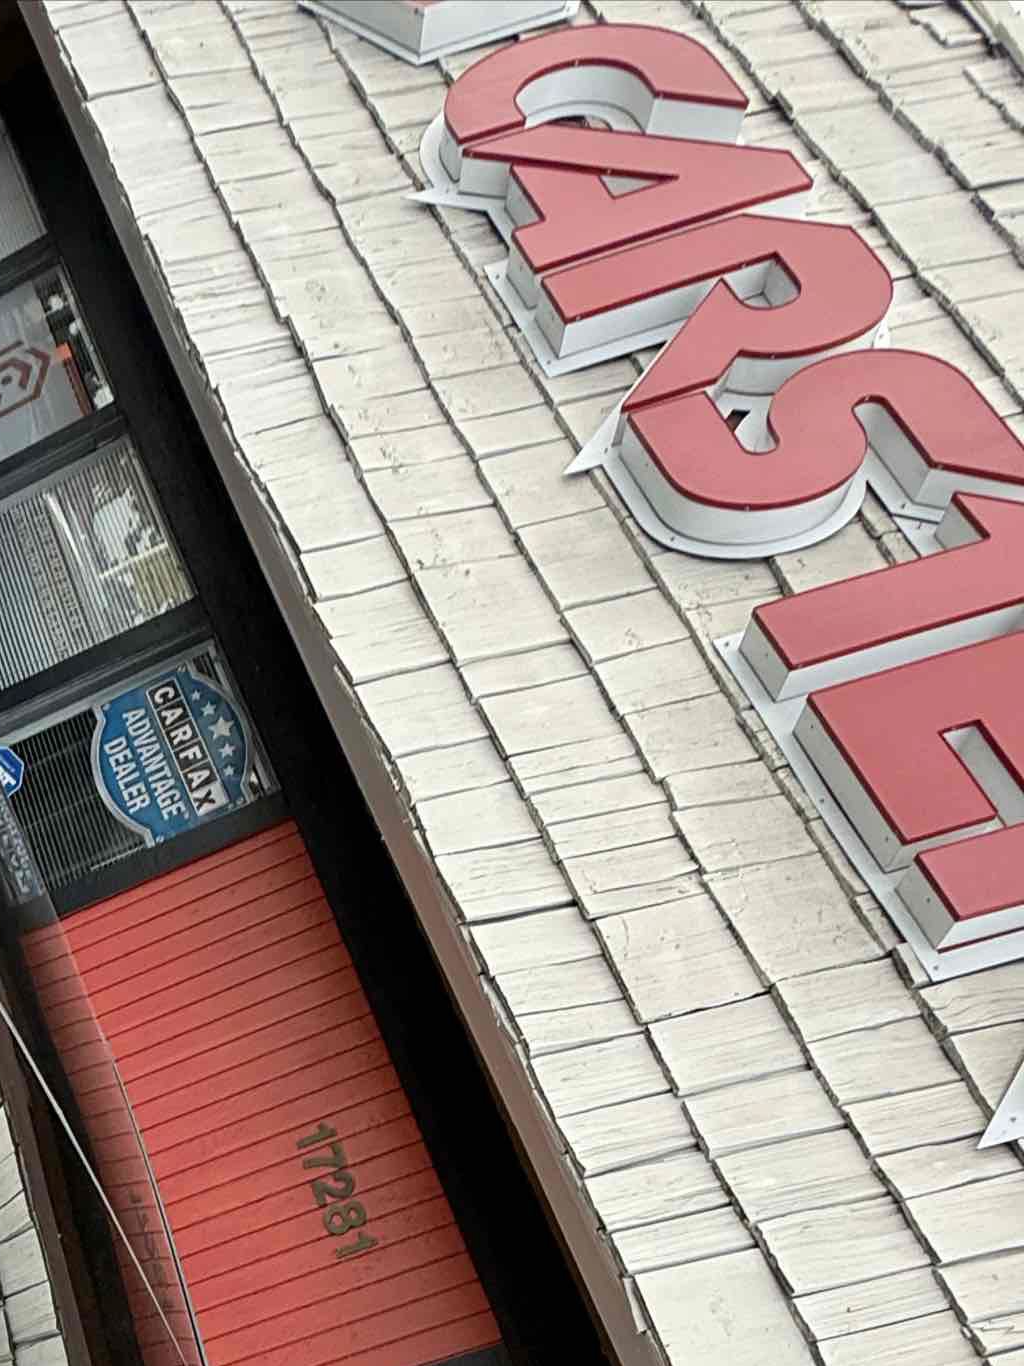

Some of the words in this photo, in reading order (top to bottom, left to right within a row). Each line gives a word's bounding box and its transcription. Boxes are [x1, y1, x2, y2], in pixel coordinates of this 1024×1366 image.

[103, 735, 152, 815] DEALER
[122, 707, 186, 821] ADVANTAGE
[150, 683, 222, 813] CARFAX
[296, 1121, 378, 1259] 17281
